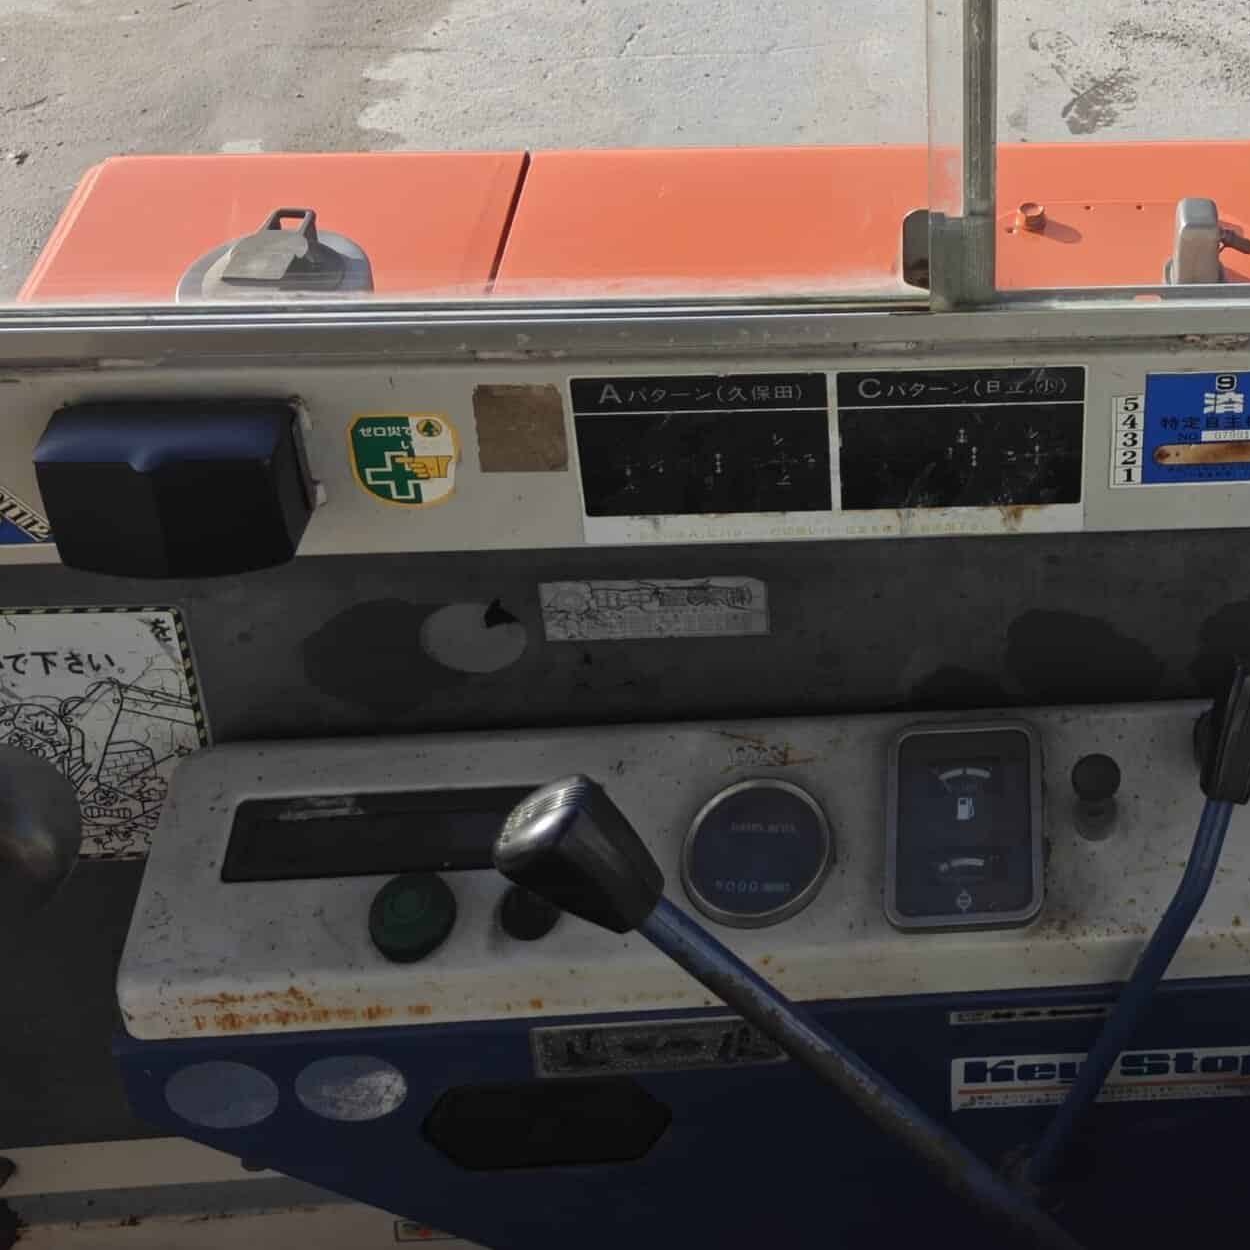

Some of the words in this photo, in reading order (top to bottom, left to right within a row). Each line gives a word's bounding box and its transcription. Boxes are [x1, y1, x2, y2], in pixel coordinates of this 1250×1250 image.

[1215, 374, 1238, 392] 9
[1123, 397, 1139, 412] 5
[1202, 391, 1245, 414] 済
[1122, 414, 1138, 430] 4
[1122, 432, 1138, 448] 3
[1121, 450, 1137, 466] 2
[1123, 467, 1135, 483] 1
[0, 651, 126, 676] で下さい。
